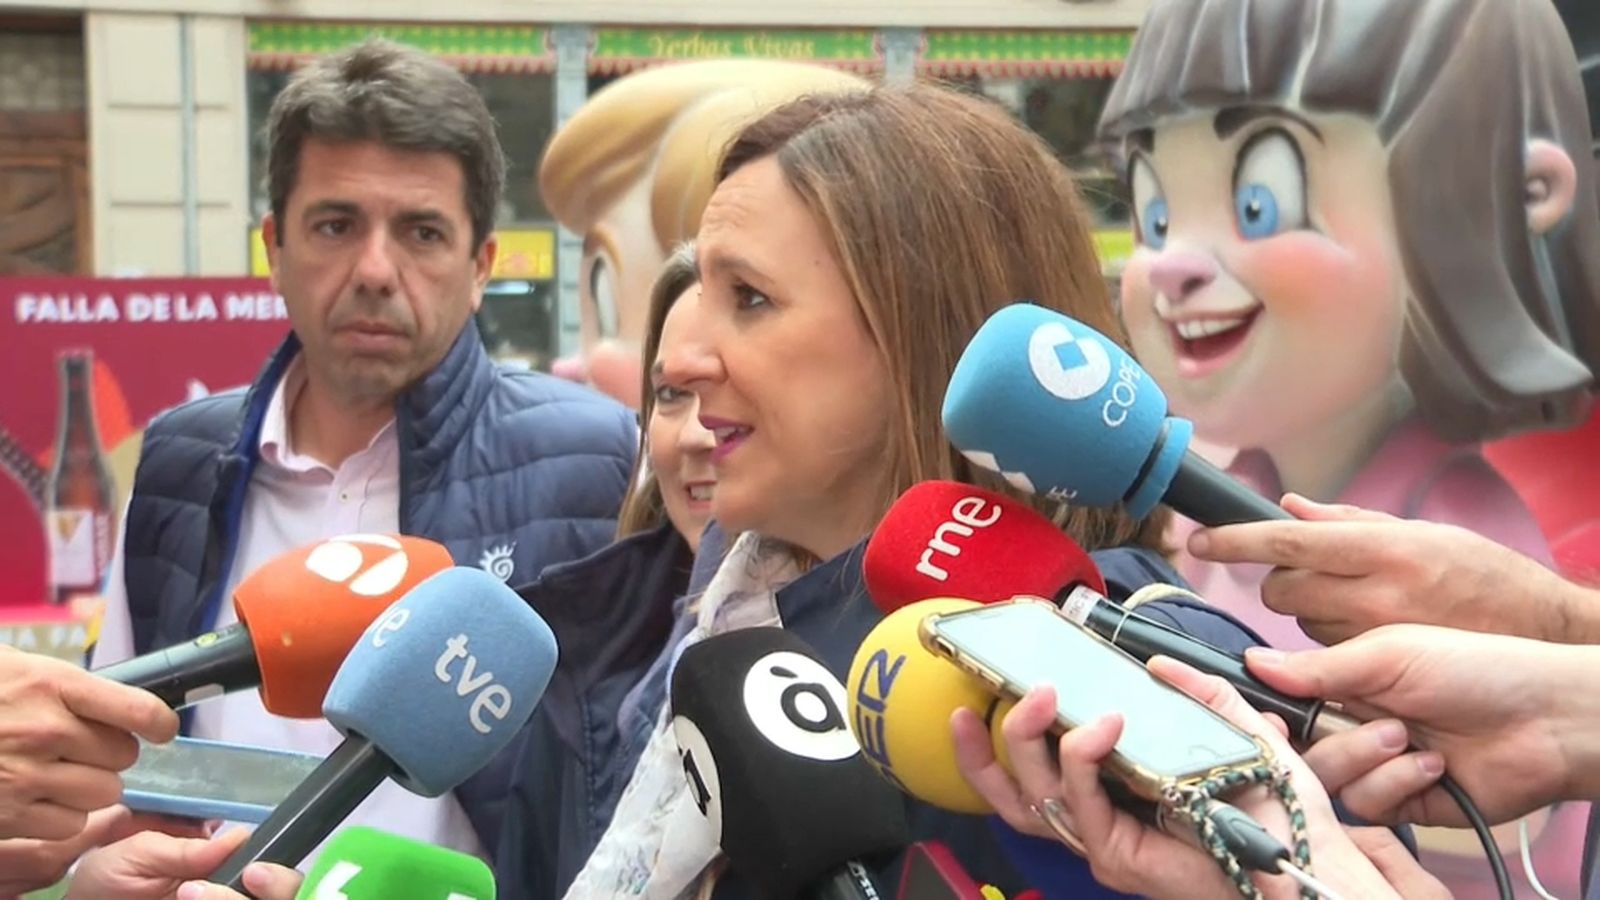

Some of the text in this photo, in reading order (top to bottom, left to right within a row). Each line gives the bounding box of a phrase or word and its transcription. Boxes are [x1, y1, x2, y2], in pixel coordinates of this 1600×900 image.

[15, 294, 120, 323] FALLA
[127, 294, 171, 322] DE
[176, 294, 218, 321] LA
[1102, 355, 1141, 428] COPE
[915, 495, 1003, 582] rne
[434, 633, 513, 735] tve
